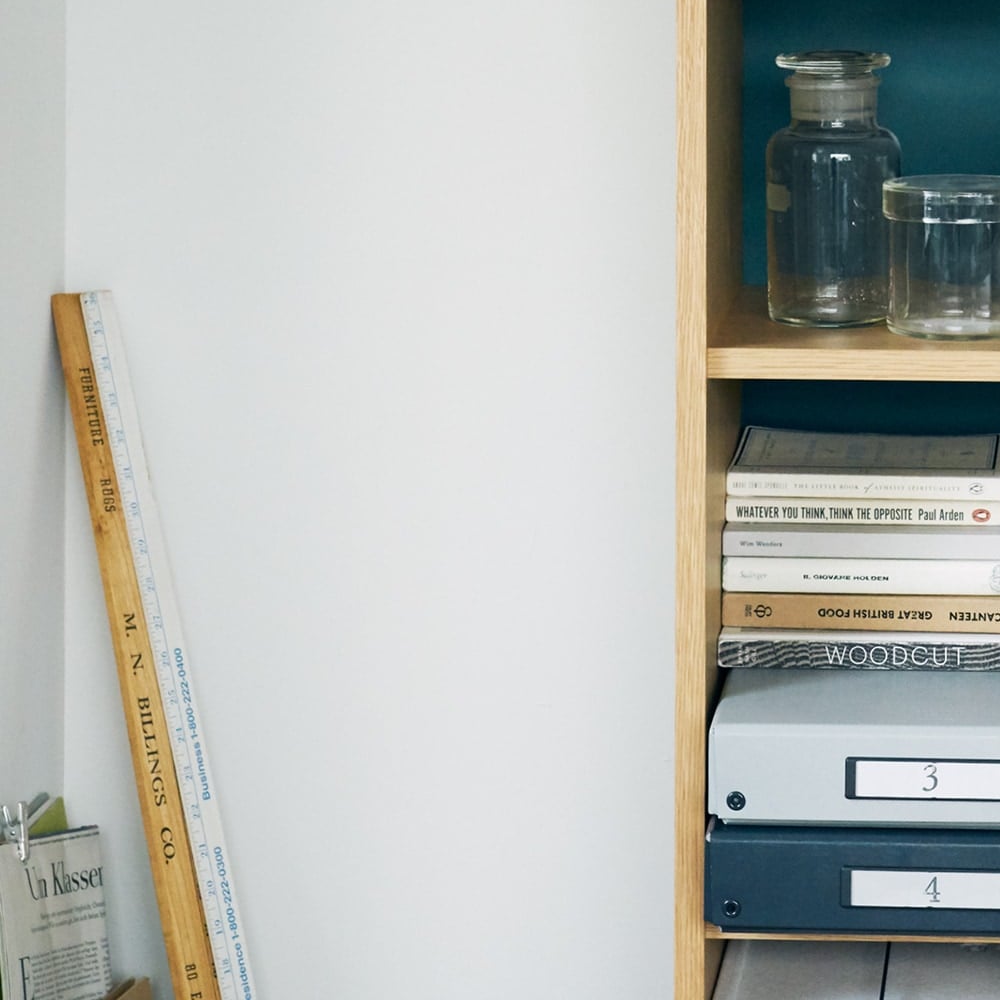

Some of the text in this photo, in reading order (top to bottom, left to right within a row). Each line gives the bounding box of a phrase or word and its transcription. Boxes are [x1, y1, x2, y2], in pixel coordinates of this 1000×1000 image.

[79, 367, 116, 513] FURNITURE RUGS
[736, 505, 779, 519] WHATEVER
[781, 506, 799, 519] YOU
[857, 508, 872, 520] THE
[873, 508, 913, 521] OPPOSITE
[918, 508, 937, 521] Paul
[939, 509, 964, 522] Arden
[817, 607, 849, 619] FOOD
[849, 608, 895, 620] BRITISH
[897, 609, 933, 620] GREAT
[825, 645, 966, 666] WOODCUT
[172, 646, 211, 801] Business 1-800-222-0400
[122, 612, 177, 865] M. N. BILLINGS CO.
[921, 764, 940, 793] 3
[24, 865, 48, 901] Un
[212, 844, 238, 941] 1-800-222-0300
[922, 875, 942, 904] 4
